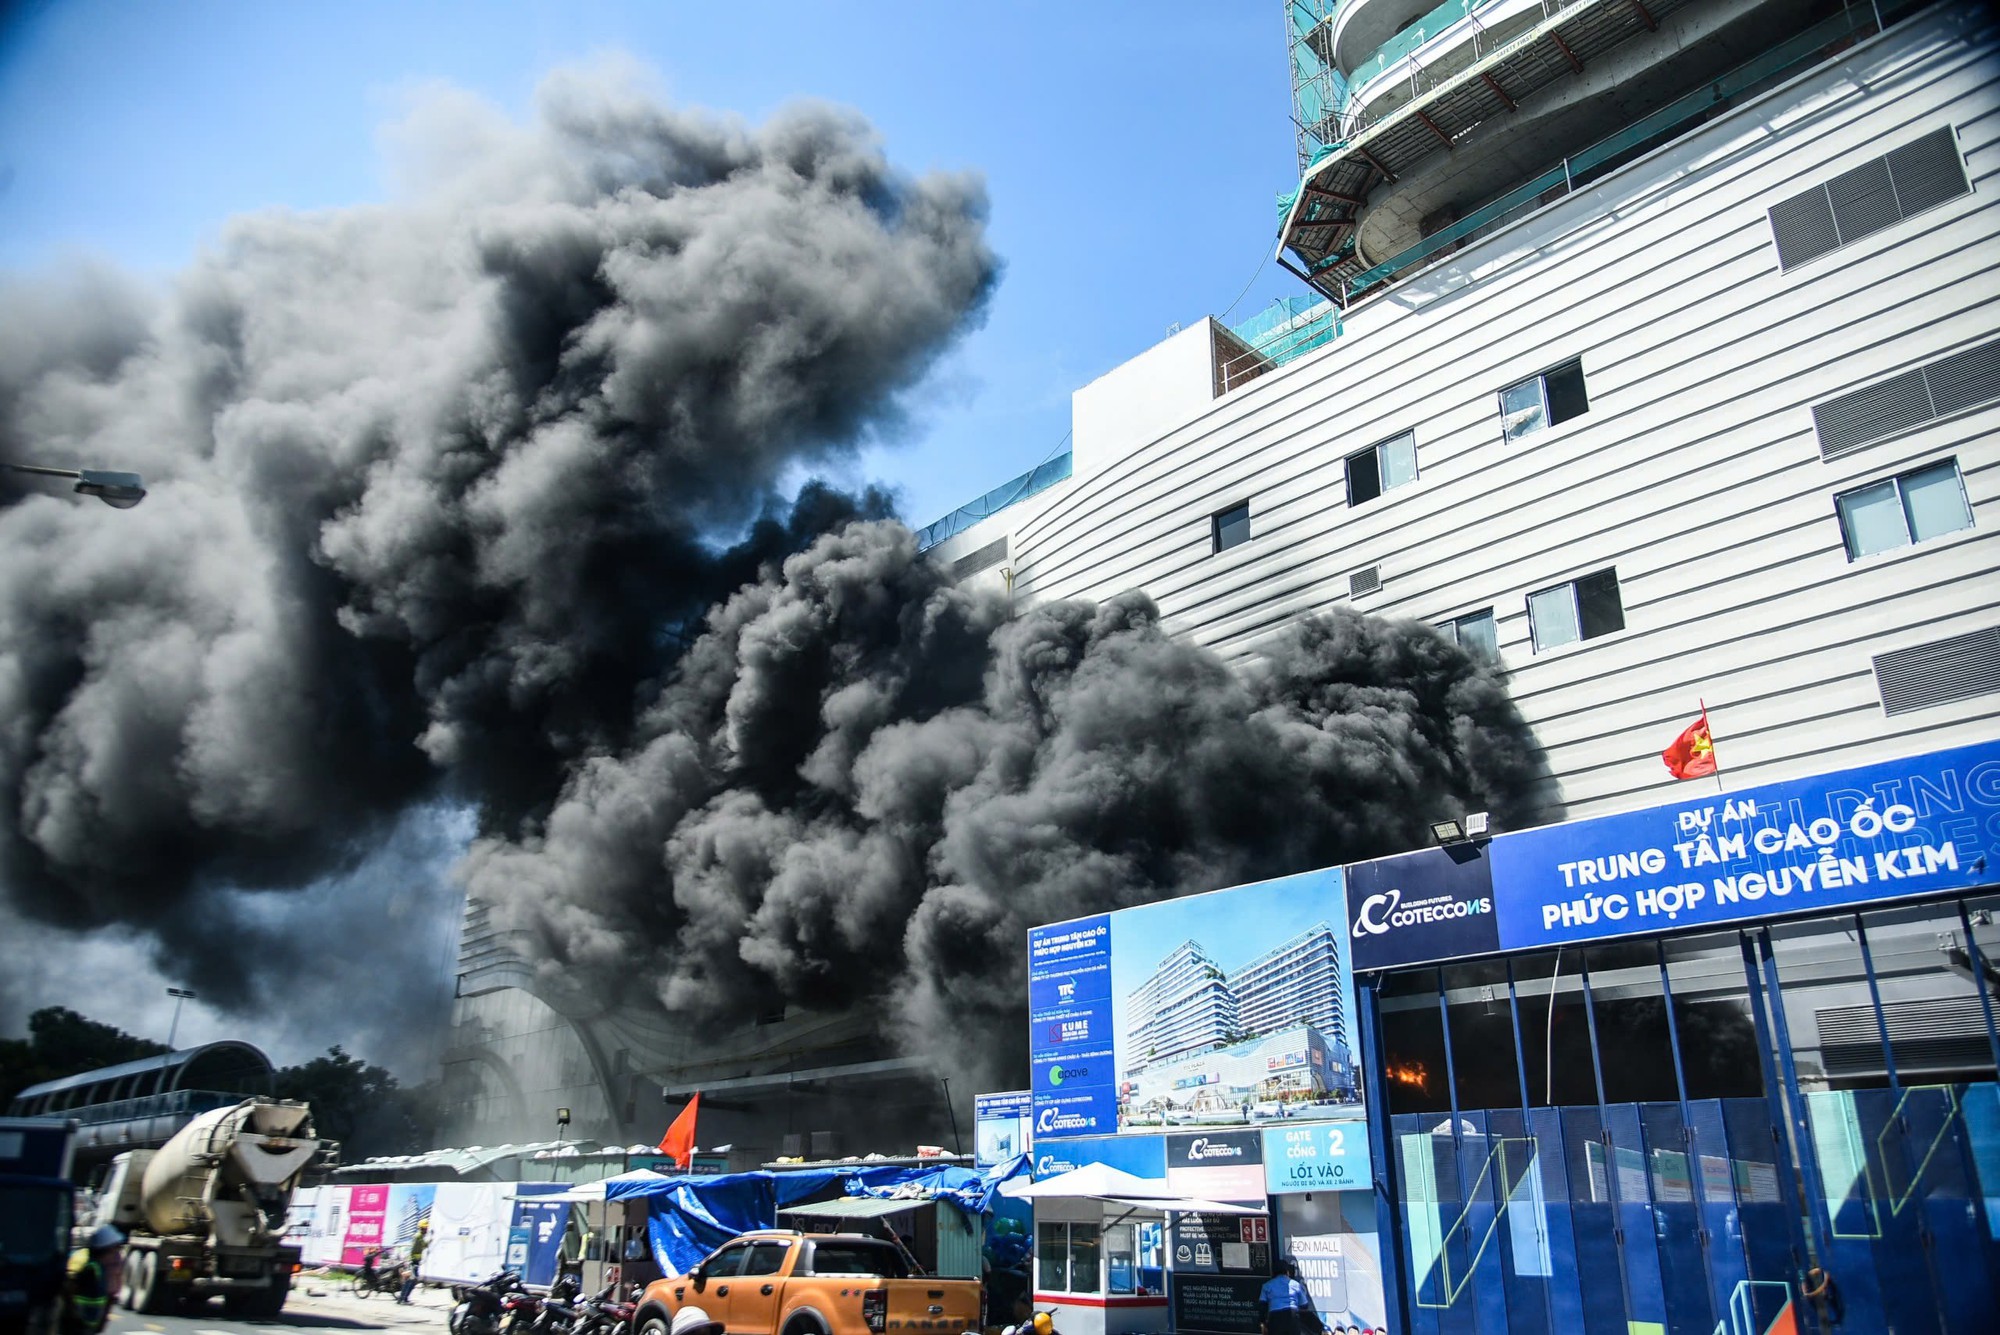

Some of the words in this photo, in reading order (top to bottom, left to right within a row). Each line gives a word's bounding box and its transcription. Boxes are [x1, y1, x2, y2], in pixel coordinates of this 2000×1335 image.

[1496, 43, 1516, 58] SAFETY
[1516, 34, 1533, 47] FIRST
[1679, 806, 1714, 833] DỰ
[1722, 798, 1757, 823] ÁN
[1557, 848, 1667, 888] TRUNG
[1673, 833, 1748, 869] TÂM
[1754, 817, 1841, 855] CAO
[1850, 797, 1917, 839] ỐC
[1542, 892, 1630, 930] PHỨC
[1636, 882, 1706, 919] HỢP
[1713, 848, 1869, 905] NGUYỄN
[1876, 841, 1959, 881] KIM
[1391, 897, 1492, 928] COTECCONS
[1082, 929, 1096, 939] CAO
[1096, 925, 1107, 936] ỐC
[1062, 1020, 1088, 1032] KUME
[1057, 1067, 1088, 1080] apave
[1053, 1117, 1097, 1129] COTECCONS
[1286, 1130, 1312, 1142] GATE
[1328, 1129, 1345, 1156] 2
[1203, 1147, 1242, 1157] COTECCONS
[1290, 1161, 1312, 1179] LỐI
[1317, 1162, 1344, 1177] VÀO
[1313, 1240, 1339, 1252] MALL
[1306, 1279, 1331, 1297] OON
[888, 1319, 978, 1329] RANGER
